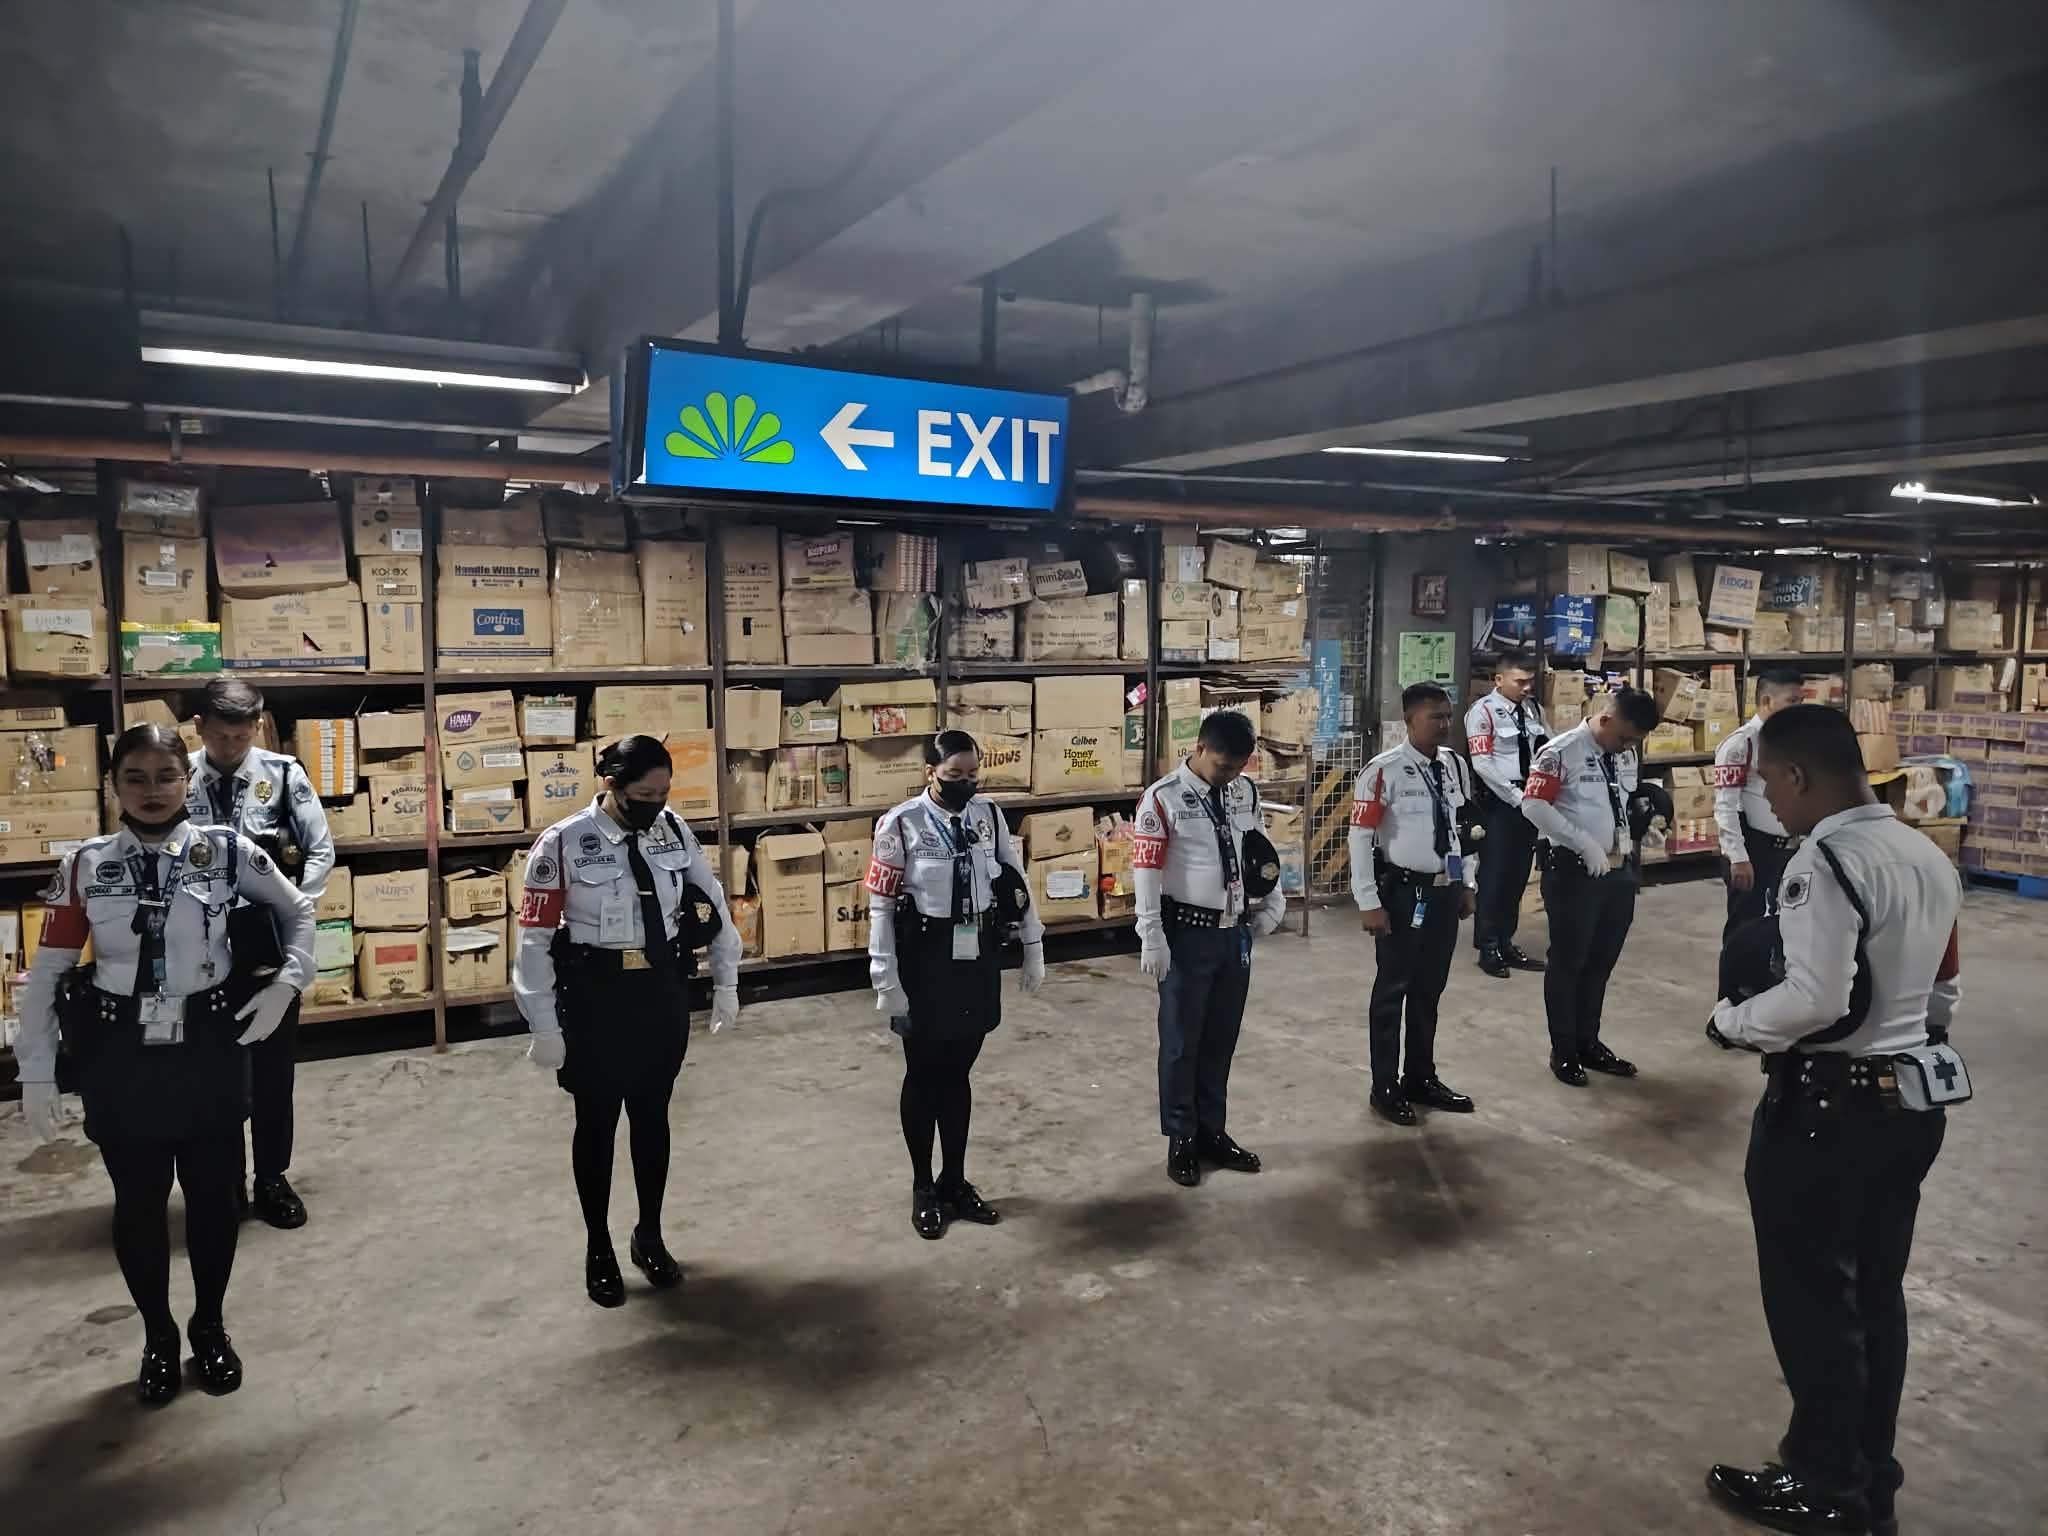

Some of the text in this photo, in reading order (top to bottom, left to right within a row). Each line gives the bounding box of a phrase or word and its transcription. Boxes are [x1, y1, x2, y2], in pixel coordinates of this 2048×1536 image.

[918, 409, 1061, 485] EXIT
[455, 565, 541, 577] Handle With Care
[449, 714, 473, 725] HANA
[1071, 735, 1098, 746] Calbee
[1063, 748, 1094, 759] Honey
[1071, 758, 1100, 769] Butter
[544, 781, 580, 799] Surf
[865, 859, 904, 896] ERT
